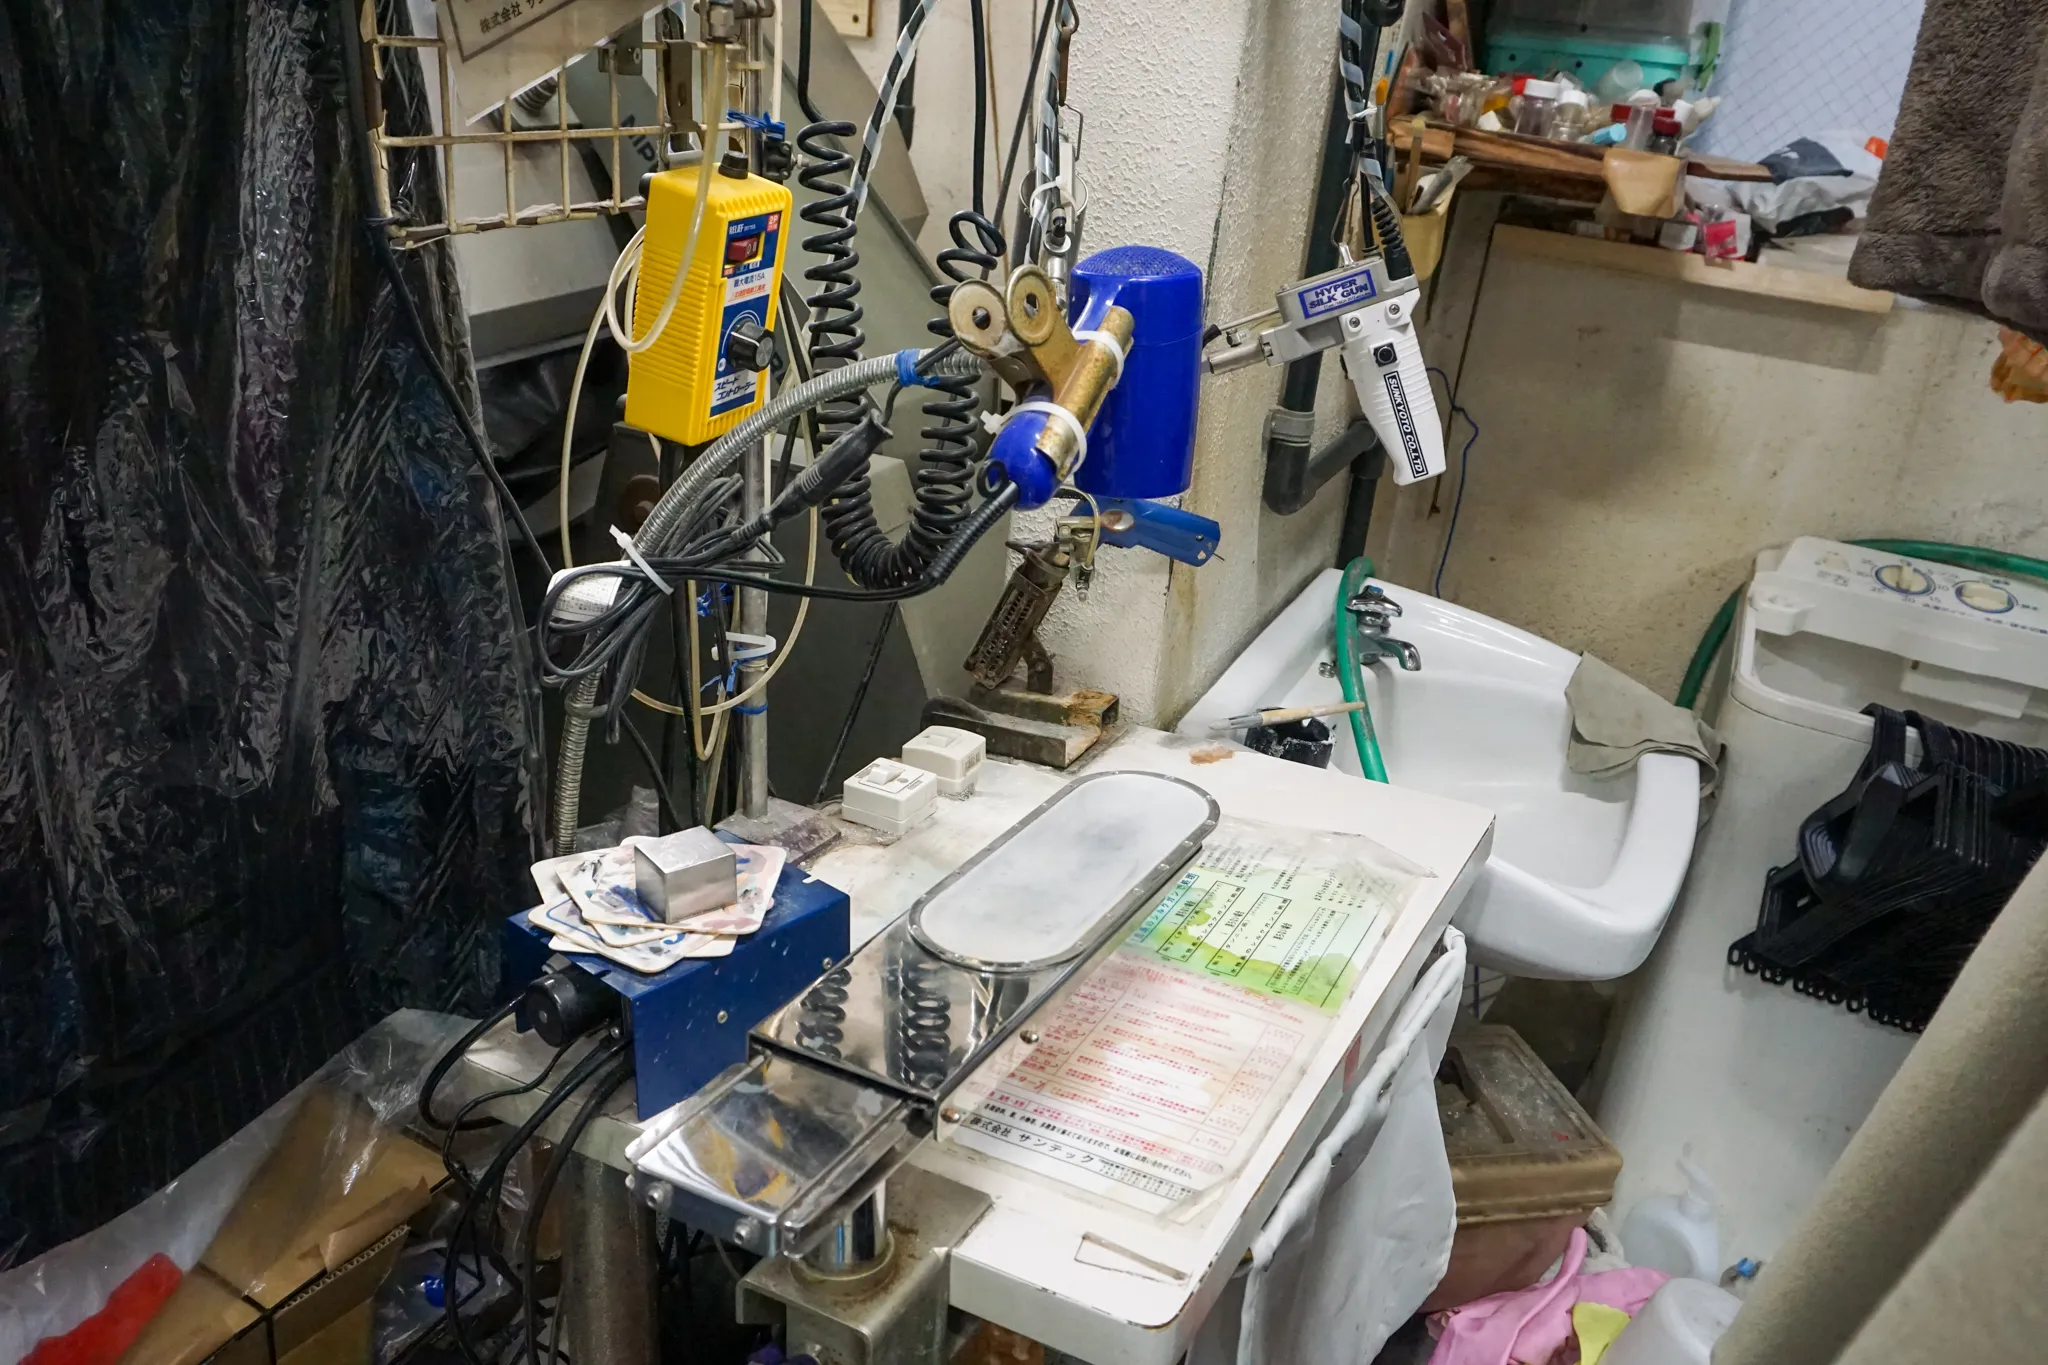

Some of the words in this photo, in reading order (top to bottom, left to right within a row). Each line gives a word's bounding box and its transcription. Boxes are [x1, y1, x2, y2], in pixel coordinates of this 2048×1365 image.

[480, 1, 522, 34] 株式会社
[1308, 293, 1337, 309] SILK
[1341, 283, 1369, 298] GUN
[1314, 278, 1357, 298] HYPER
[716, 382, 756, 401] コントローラー
[1389, 378, 1411, 433] SUNKYOTO
[970, 1116, 1012, 1138] 株式会社
[1018, 1133, 1095, 1164] サンテック
